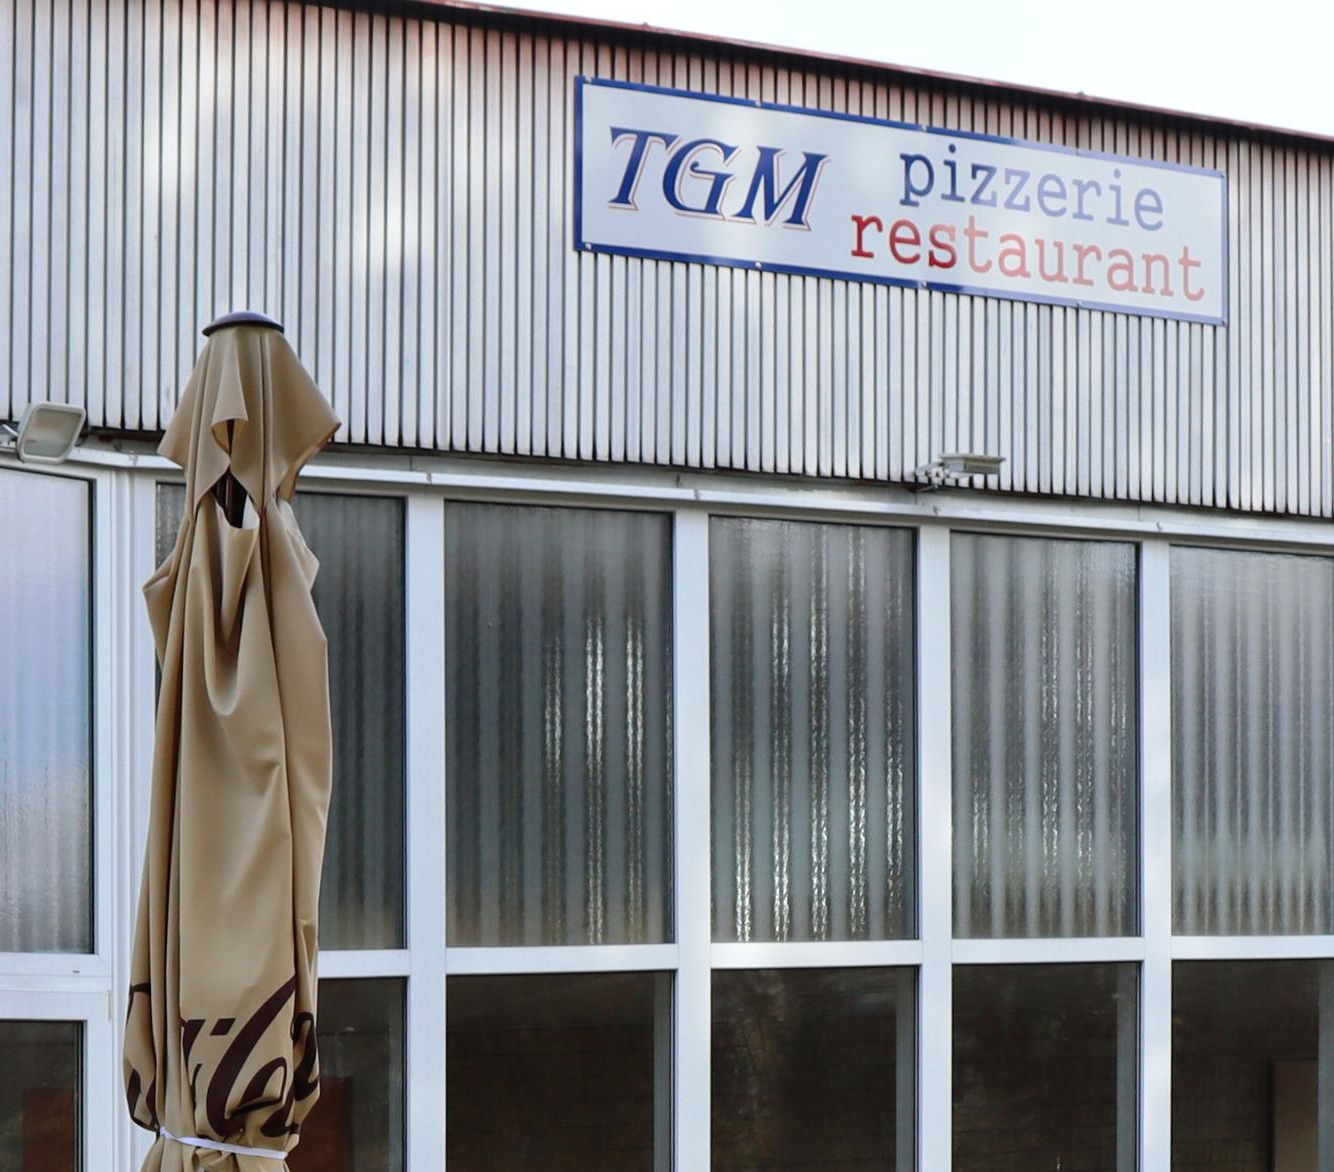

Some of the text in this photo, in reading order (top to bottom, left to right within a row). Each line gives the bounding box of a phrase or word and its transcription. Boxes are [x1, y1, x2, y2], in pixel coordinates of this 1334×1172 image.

[609, 126, 829, 232] TGM
[899, 143, 1164, 231] pizzerie
[850, 214, 1206, 302] restaurant
